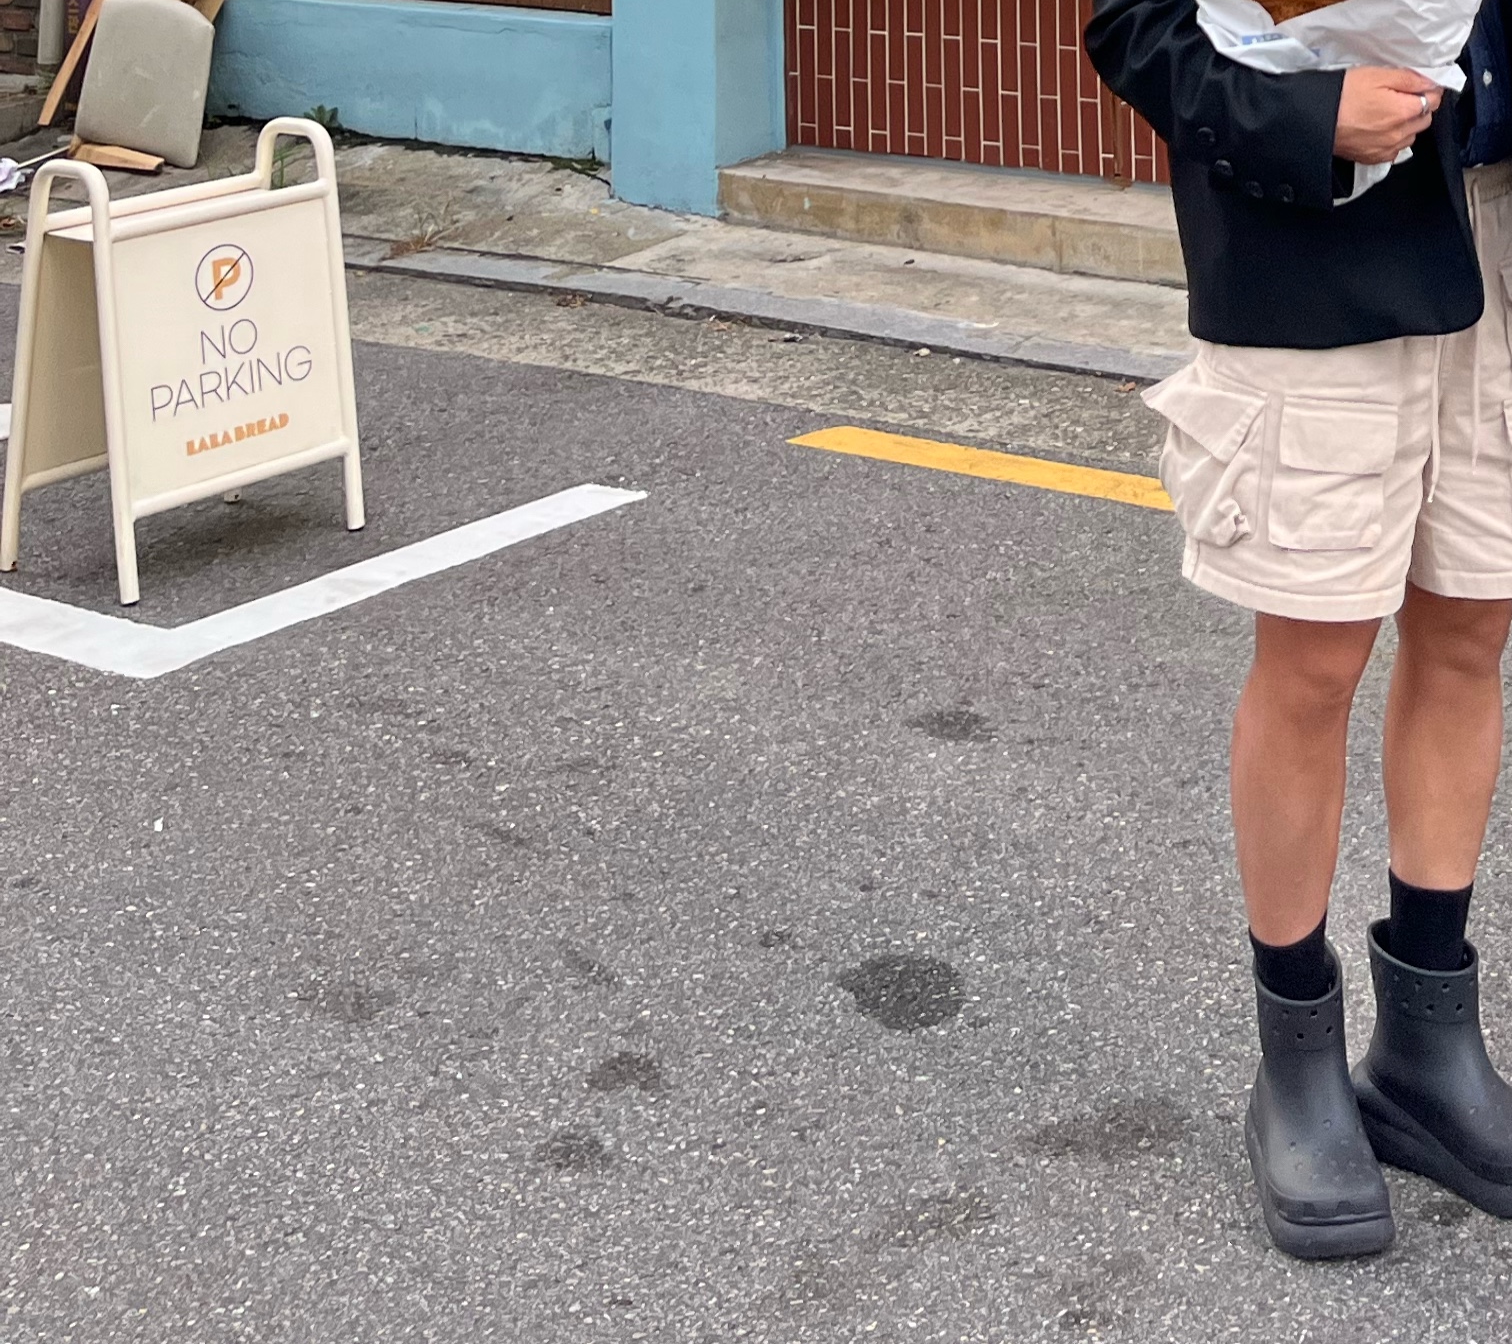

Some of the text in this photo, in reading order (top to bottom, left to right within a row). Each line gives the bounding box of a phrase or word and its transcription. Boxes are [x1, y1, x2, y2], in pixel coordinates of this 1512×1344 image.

[200, 318, 258, 365] NO
[150, 345, 313, 423] PARKING
[234, 412, 290, 443] BREAD
